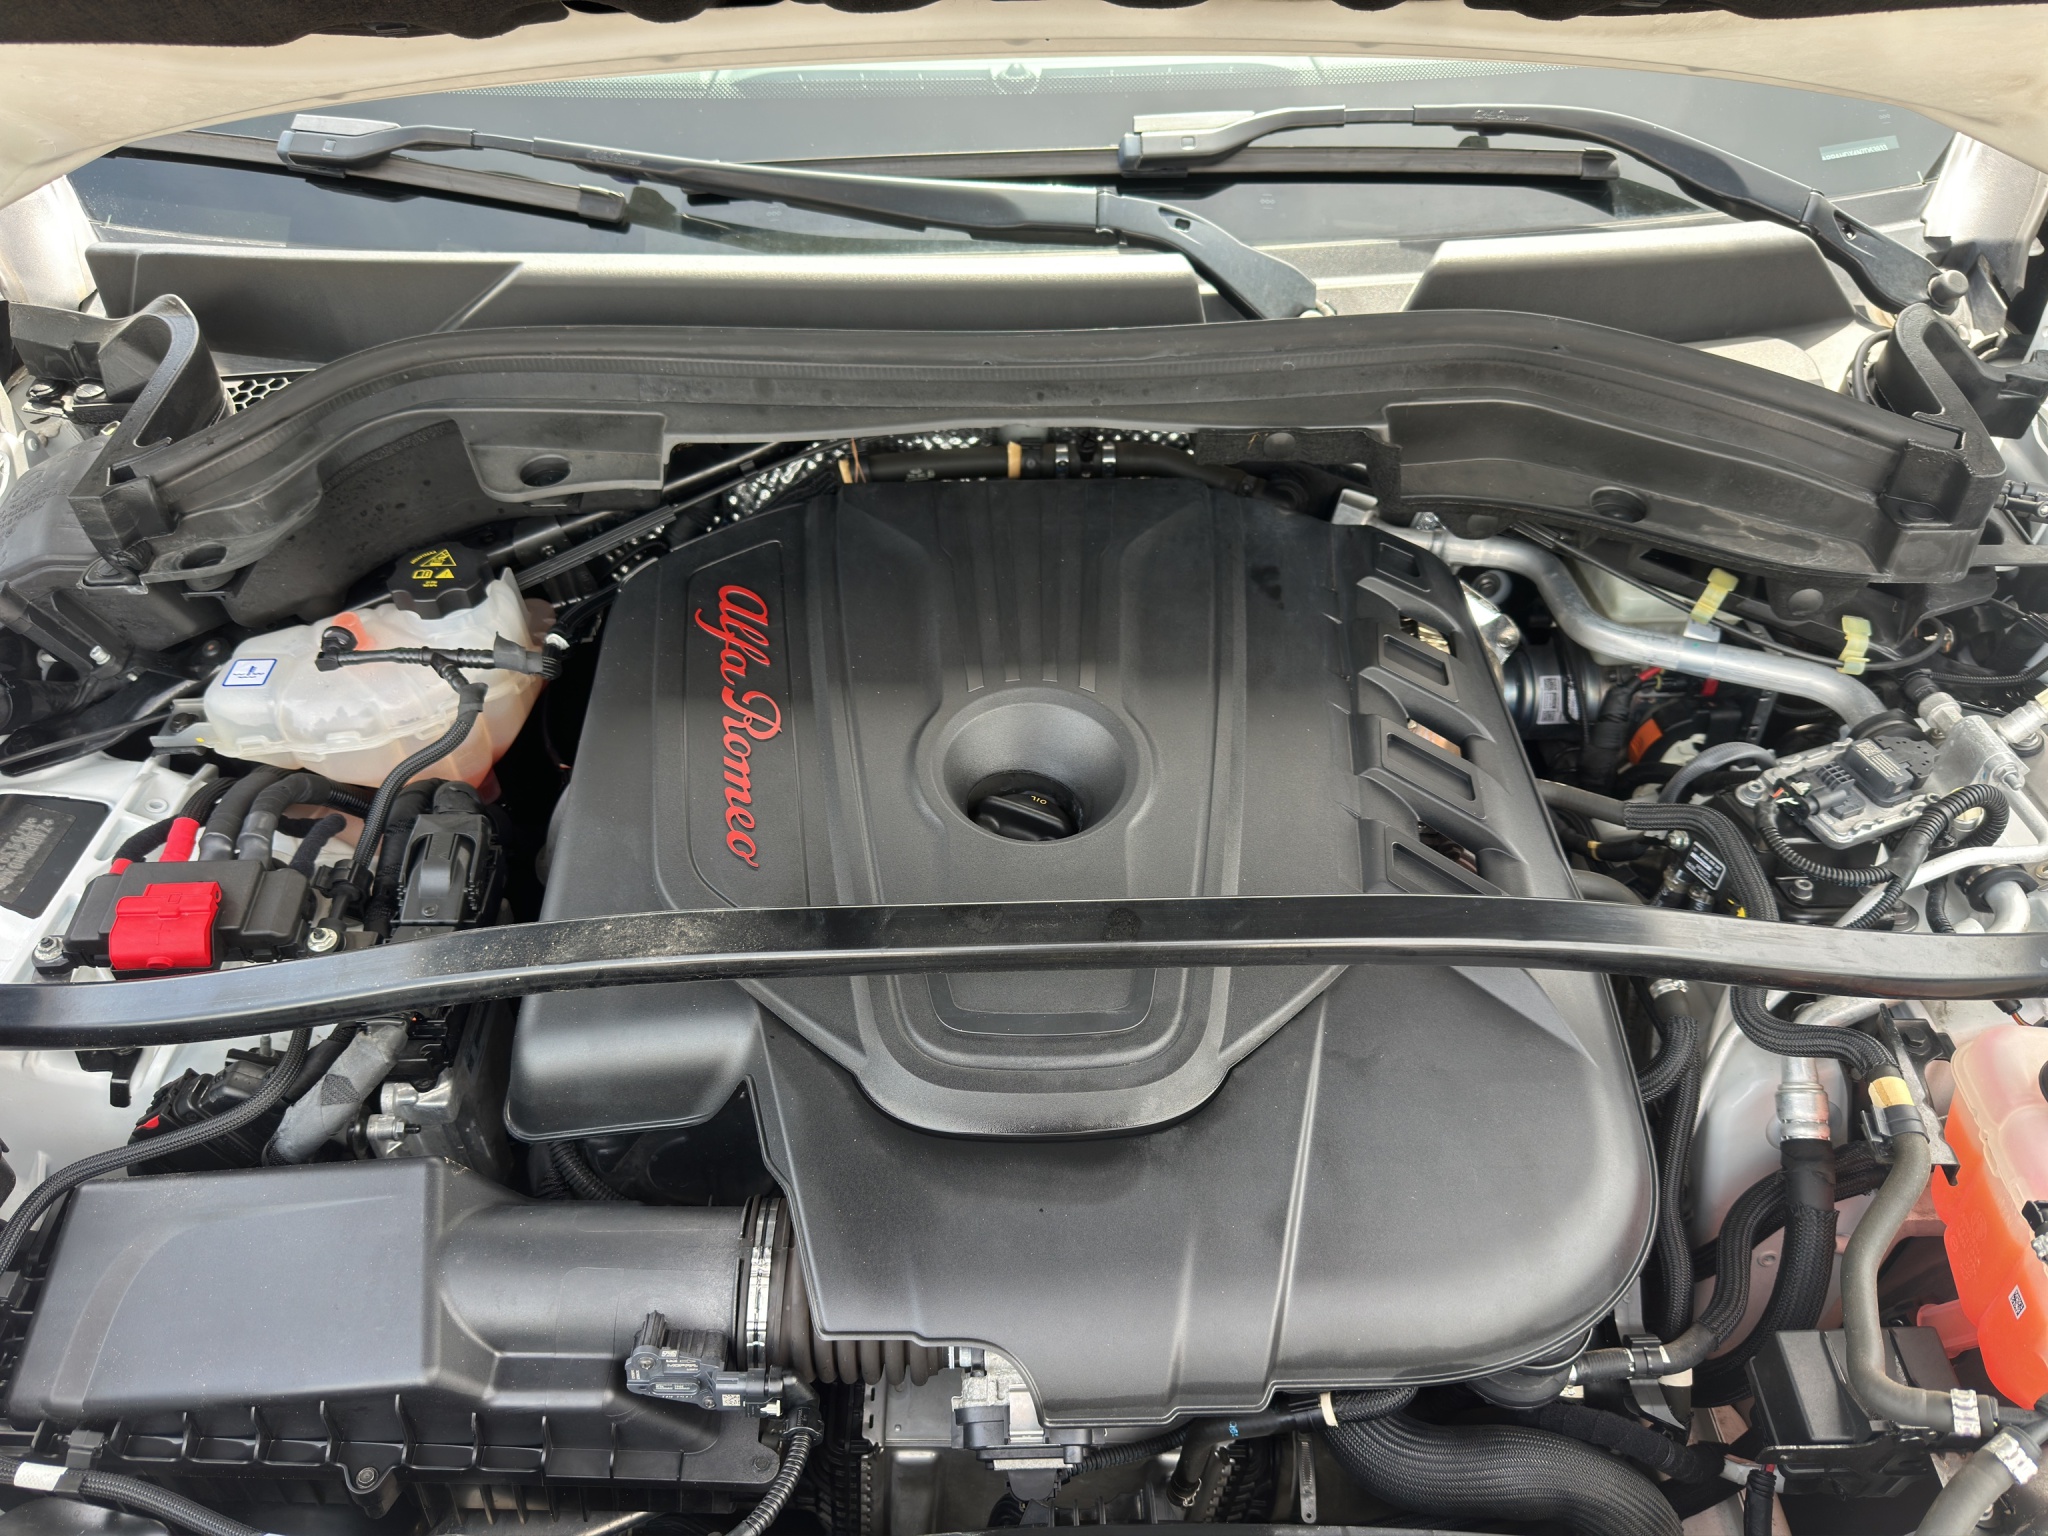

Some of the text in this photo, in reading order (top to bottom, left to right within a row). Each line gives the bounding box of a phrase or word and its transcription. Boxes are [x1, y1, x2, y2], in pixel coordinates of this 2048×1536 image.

[694, 585, 782, 868] Alfa Romeo
[1031, 795, 1047, 805] OIL
